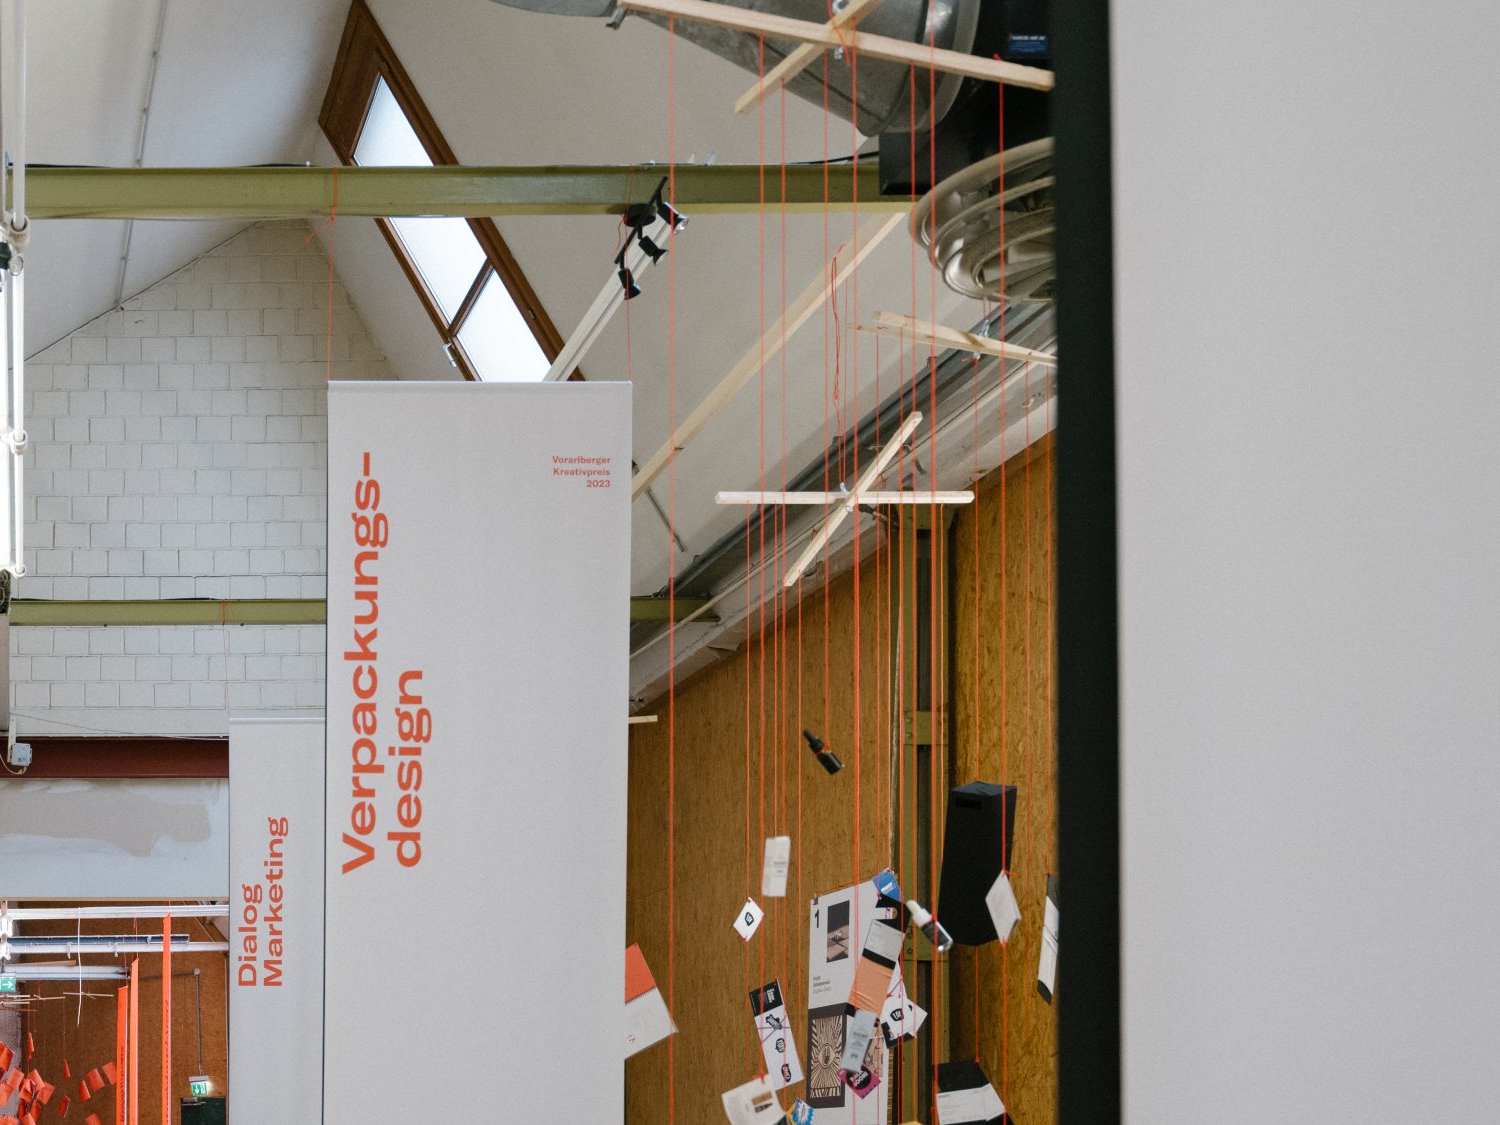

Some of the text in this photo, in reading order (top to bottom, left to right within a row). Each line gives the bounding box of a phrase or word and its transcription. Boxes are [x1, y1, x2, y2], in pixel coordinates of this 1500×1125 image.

[551, 455, 612, 465] Vorarlberger
[552, 467, 611, 477] Kreativpreis
[586, 479, 611, 488] 2023
[341, 451, 388, 874] Verpackungs-
[387, 670, 432, 868] design
[238, 884, 263, 987] Dialog
[263, 817, 289, 987] Marketing
